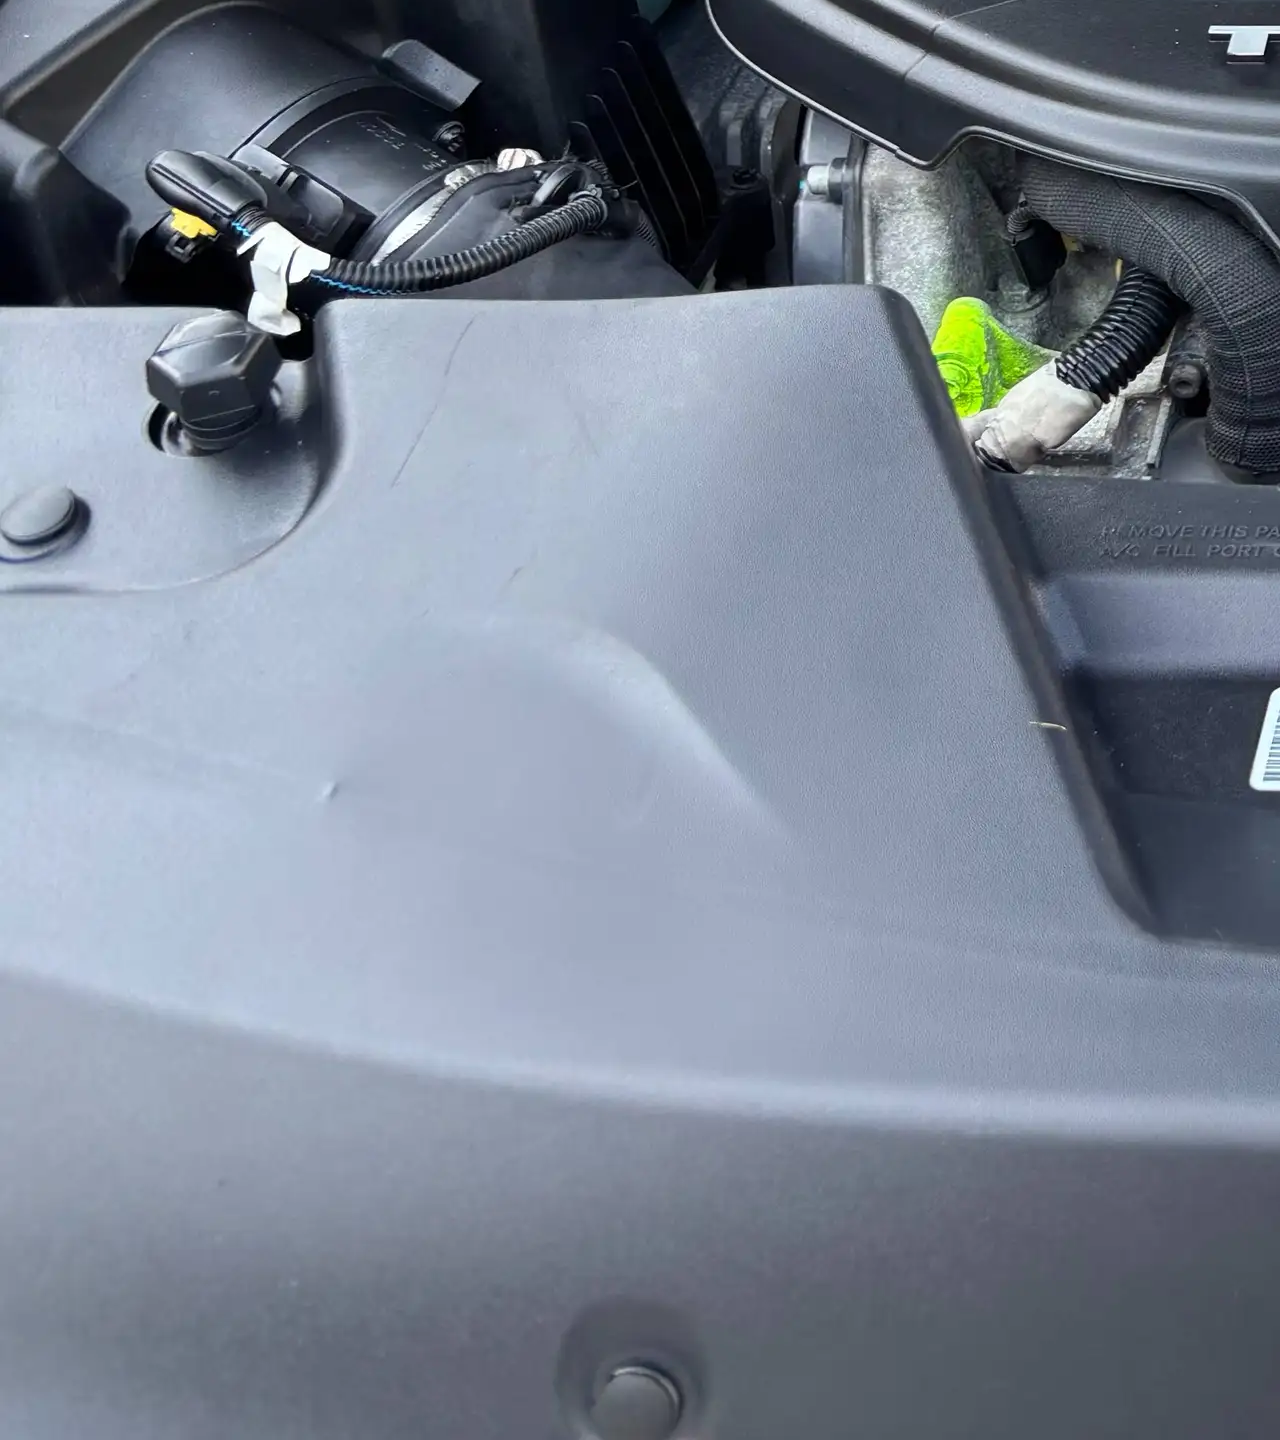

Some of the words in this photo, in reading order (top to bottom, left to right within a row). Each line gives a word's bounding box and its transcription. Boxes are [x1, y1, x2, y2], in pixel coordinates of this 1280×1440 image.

[1201, 525, 1248, 538] THIS
[1153, 544, 1196, 557] FILL
[1207, 544, 1266, 558] PORT
